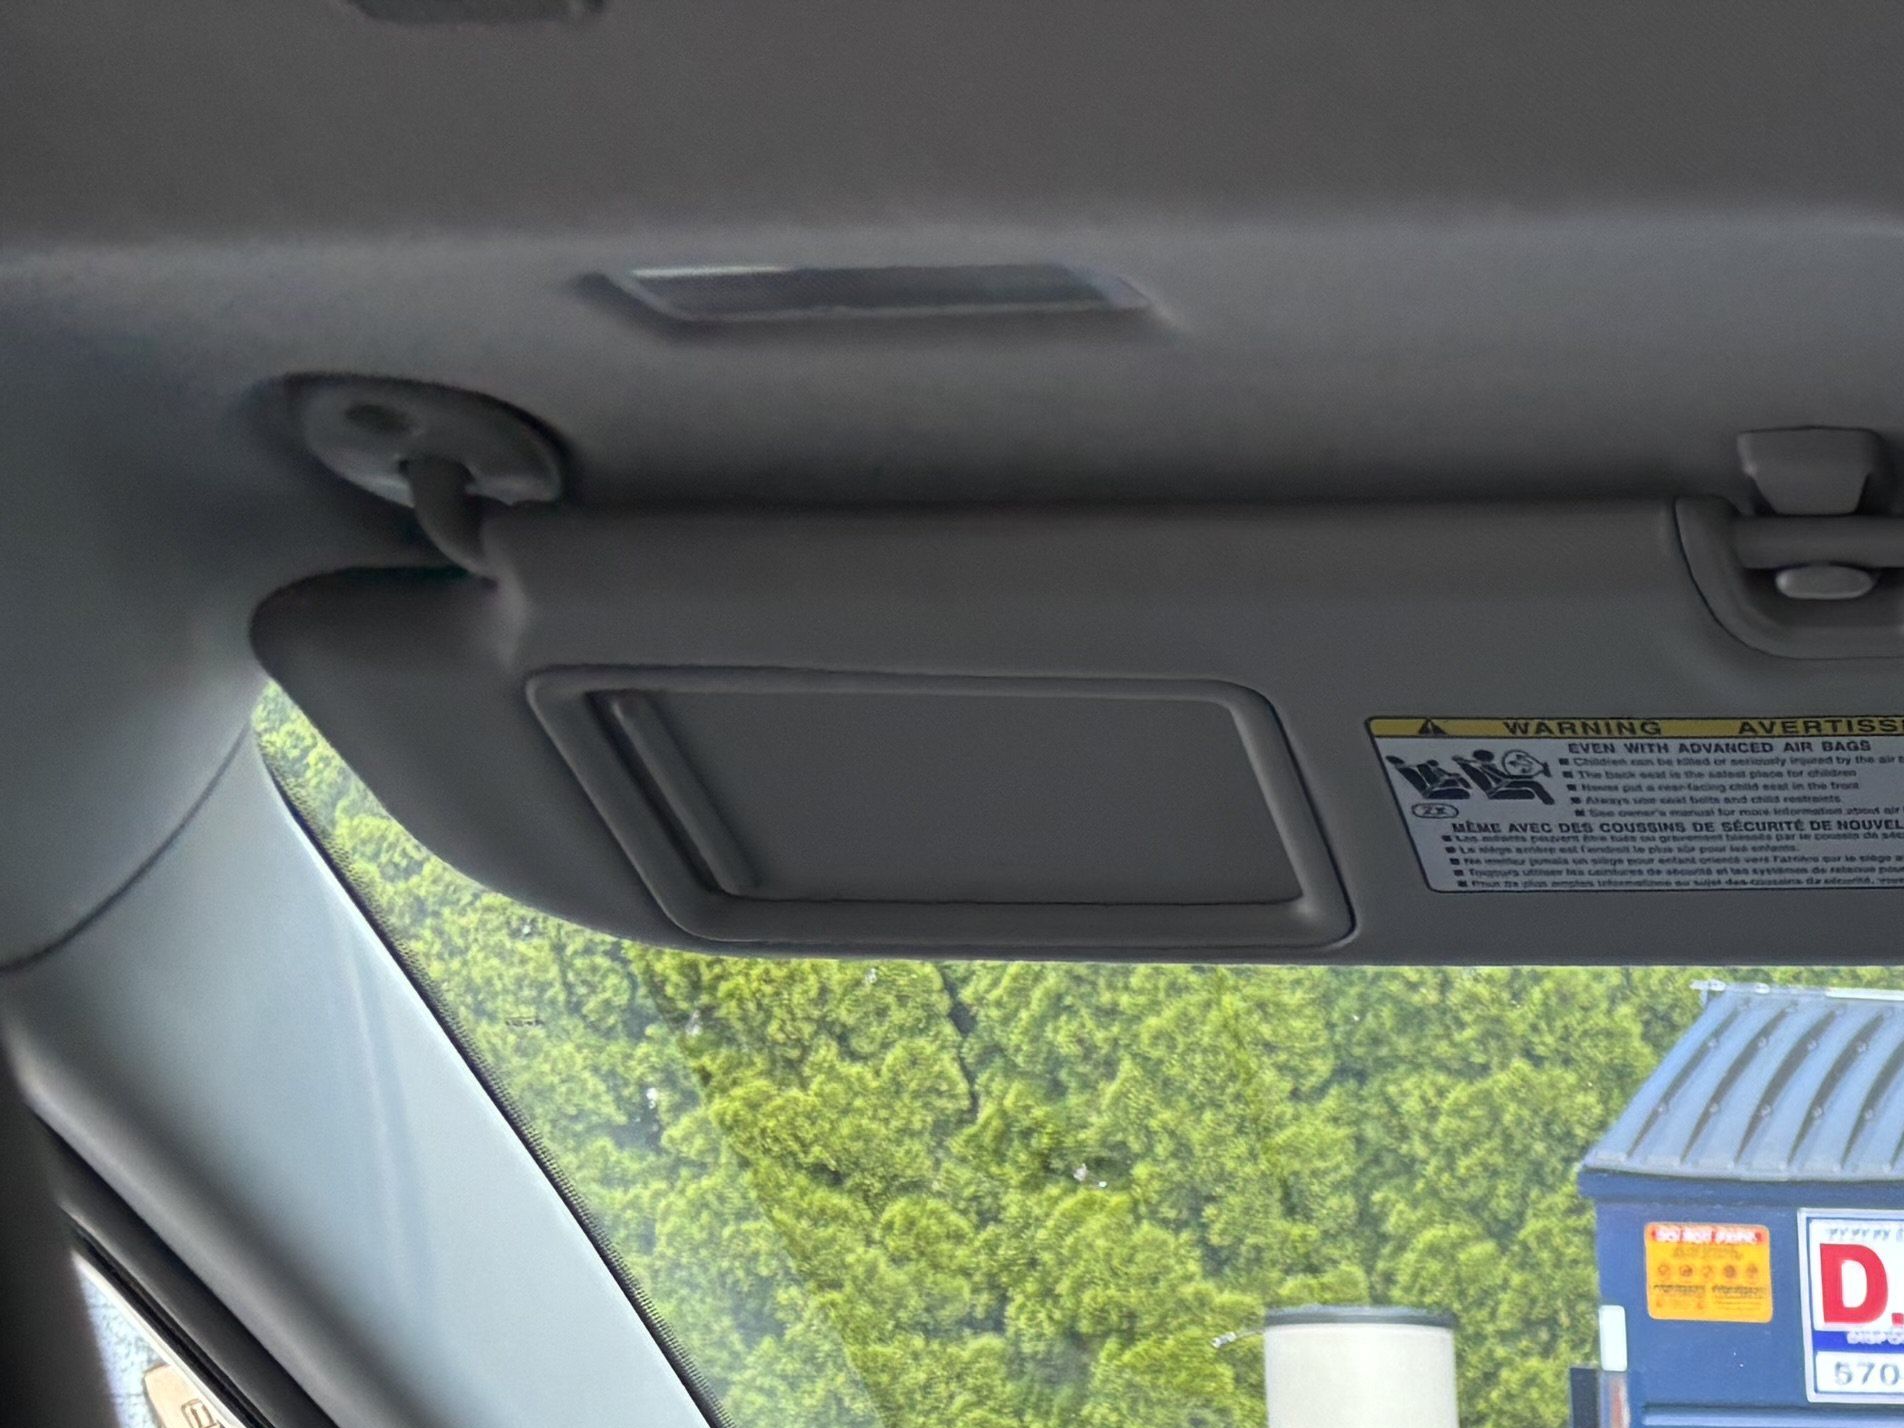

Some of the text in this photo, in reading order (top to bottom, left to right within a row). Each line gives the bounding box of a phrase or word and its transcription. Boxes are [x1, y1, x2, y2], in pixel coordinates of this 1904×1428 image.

[1503, 720, 1662, 736] WARNING
[1568, 740, 1871, 754] EVEN WITH ADVANCED AIR BAGS
[1508, 822, 1553, 833] AVEC
[1558, 822, 1594, 833] DES
[1599, 821, 1687, 833] COUSSINS
[1691, 821, 1716, 832] DE
[1720, 818, 1806, 832] SÉCURITÉ
[1809, 820, 1833, 831] DE
